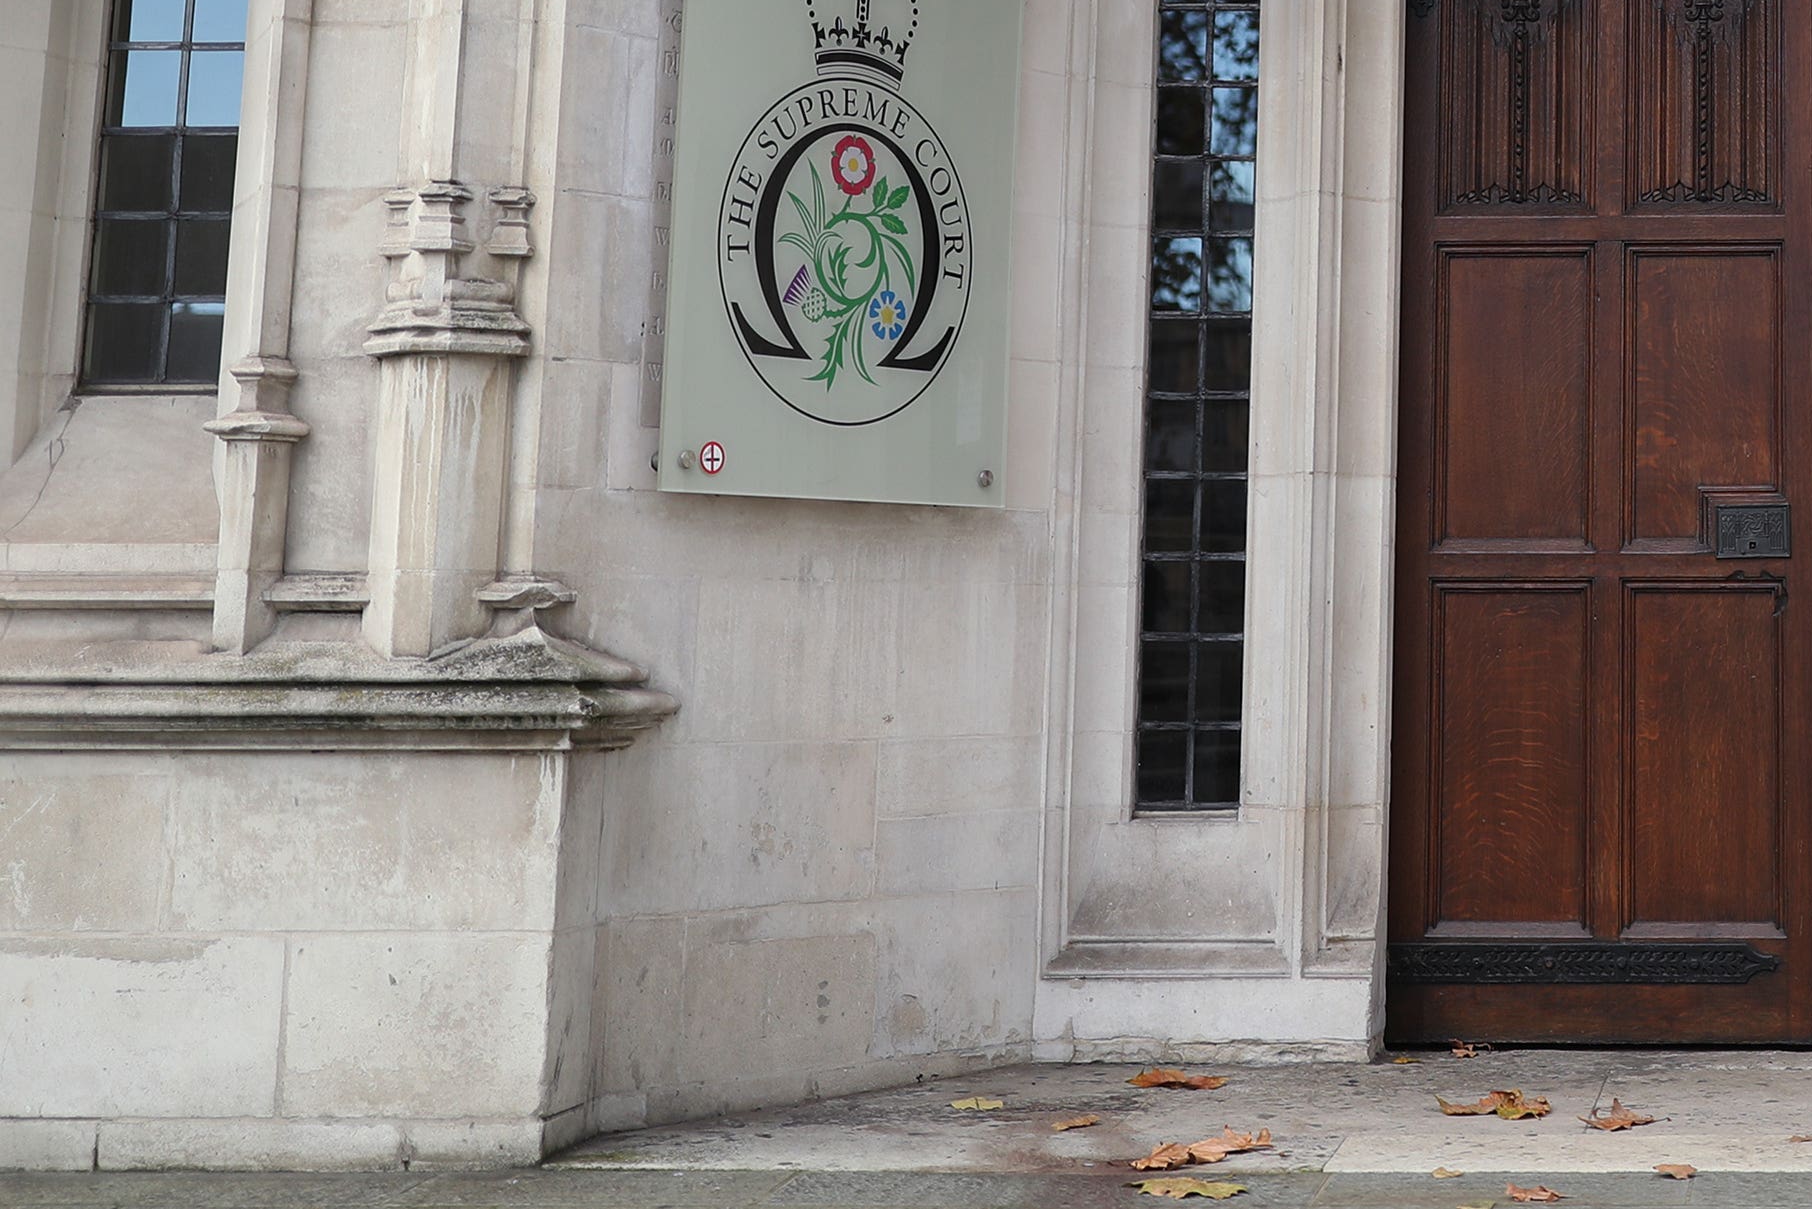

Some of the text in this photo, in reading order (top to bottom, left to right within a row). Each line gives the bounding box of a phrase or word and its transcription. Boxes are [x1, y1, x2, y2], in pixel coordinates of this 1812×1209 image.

[727, 88, 965, 290] THE SUPREME COURT
